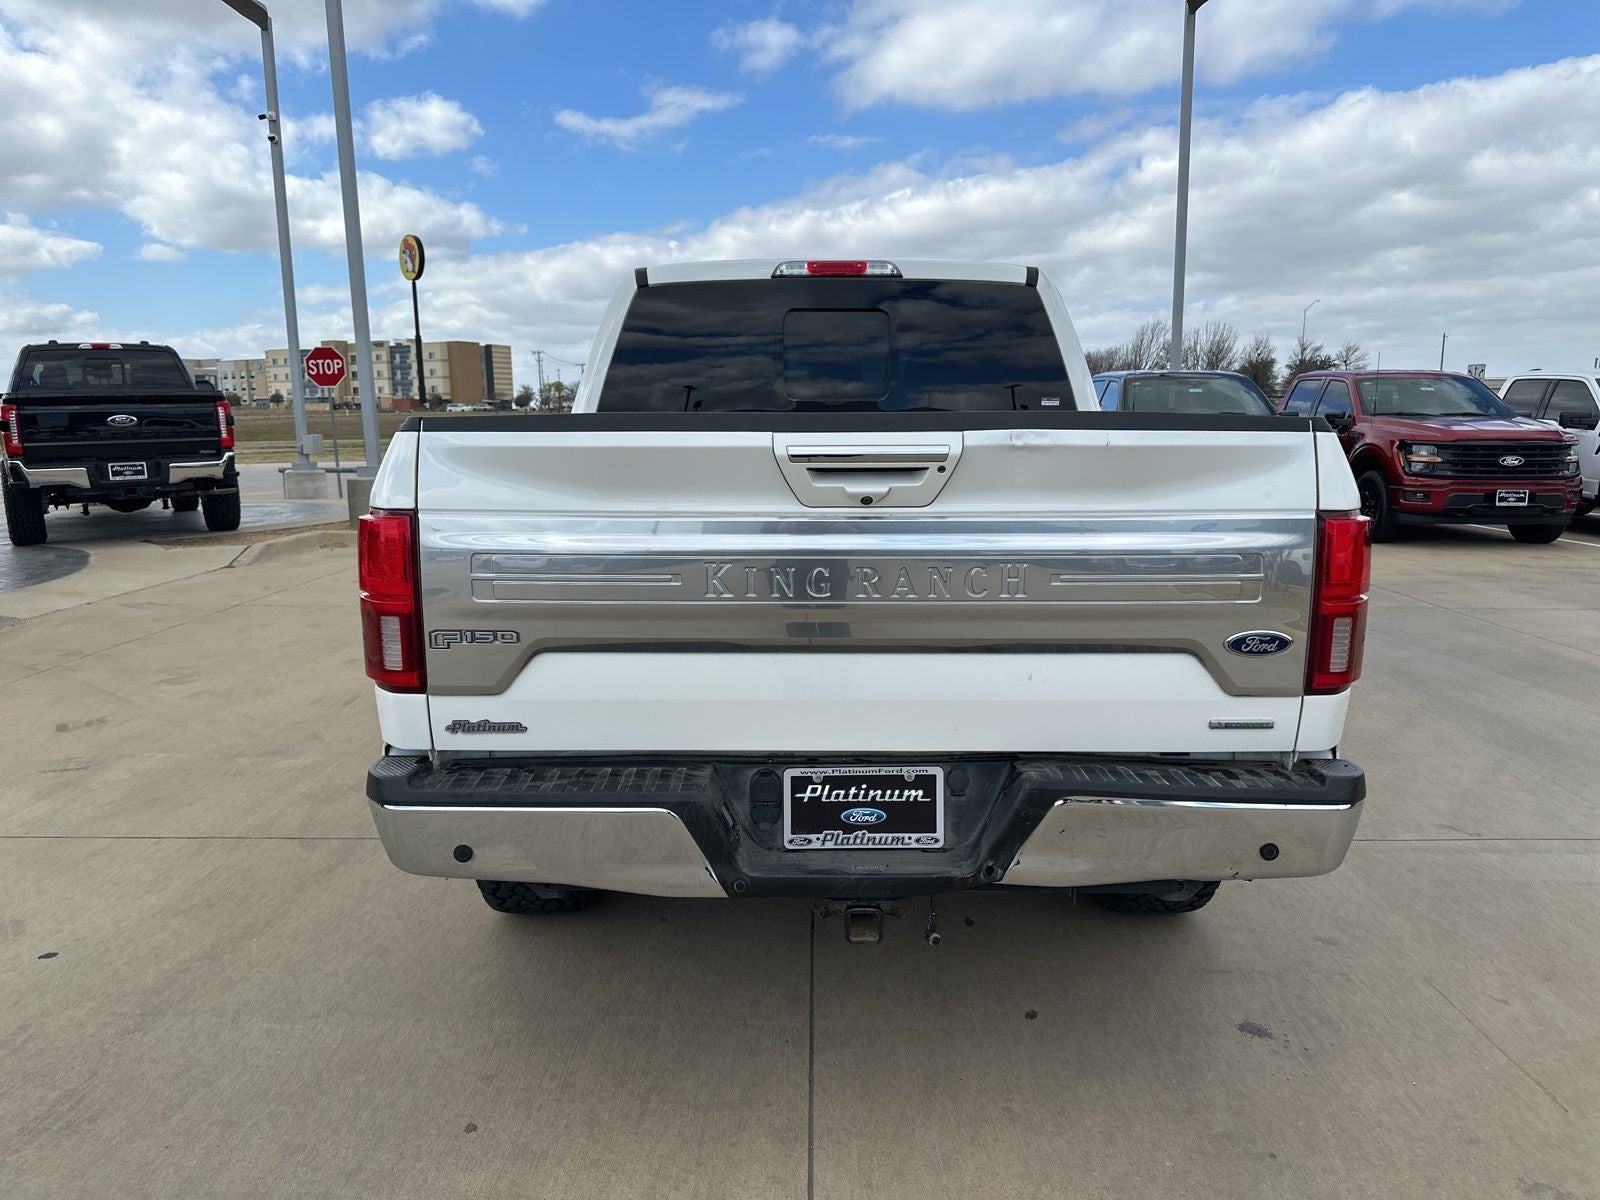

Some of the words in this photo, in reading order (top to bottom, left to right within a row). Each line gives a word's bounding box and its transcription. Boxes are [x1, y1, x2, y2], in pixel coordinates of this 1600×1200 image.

[308, 358, 343, 375] STOP
[703, 561, 832, 598] KING
[855, 561, 1029, 598] RANCH
[429, 629, 520, 649] F150
[1241, 636, 1280, 652] Ford
[445, 719, 528, 734] Platinum
[794, 783, 932, 803] Platinum
[849, 809, 878, 822] Ford
[820, 830, 913, 846] Platinum
